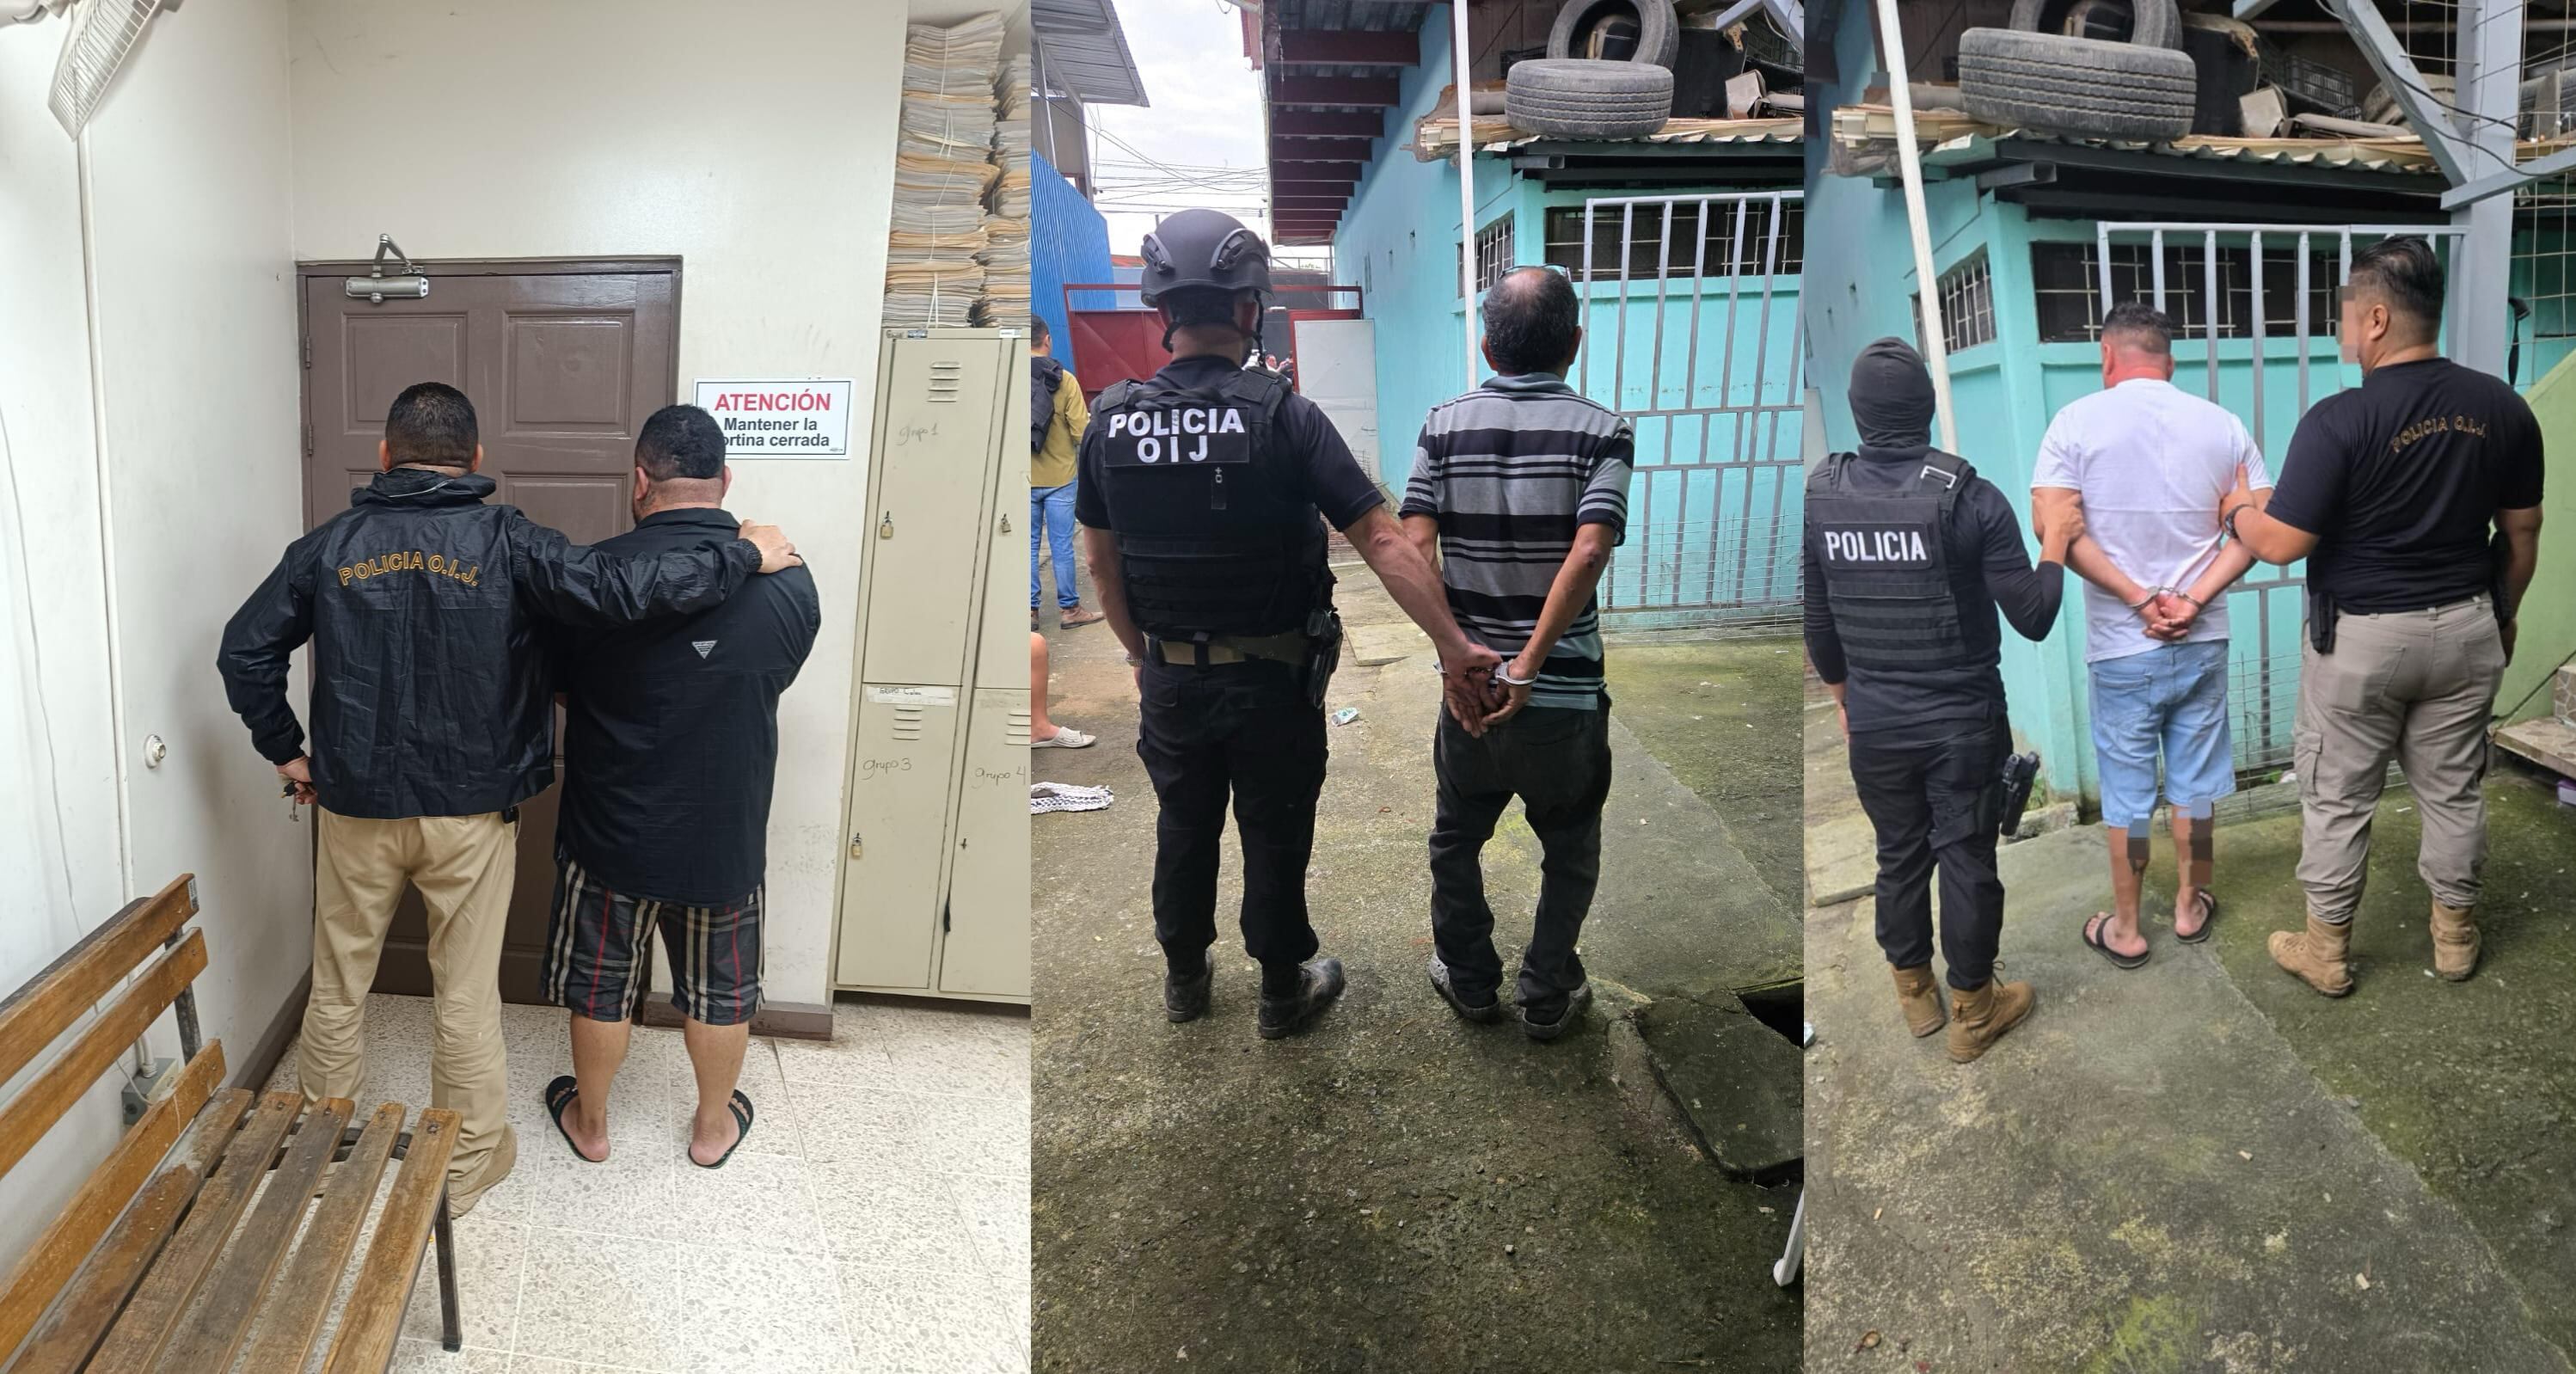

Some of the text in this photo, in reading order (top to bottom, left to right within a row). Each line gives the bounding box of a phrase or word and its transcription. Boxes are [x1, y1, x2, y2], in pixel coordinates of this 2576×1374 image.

[715, 389, 831, 411] ATENCIÓN
[724, 418, 818, 431] Mantener la
[1107, 408, 1246, 439] POLICIA
[2391, 416, 2449, 453] POLICIA
[724, 432, 830, 446] ortina cerrada
[1824, 531, 1927, 561] POLICIA
[338, 551, 479, 587] POLICIA O.I.J.
[861, 757, 912, 780] grupo 3
